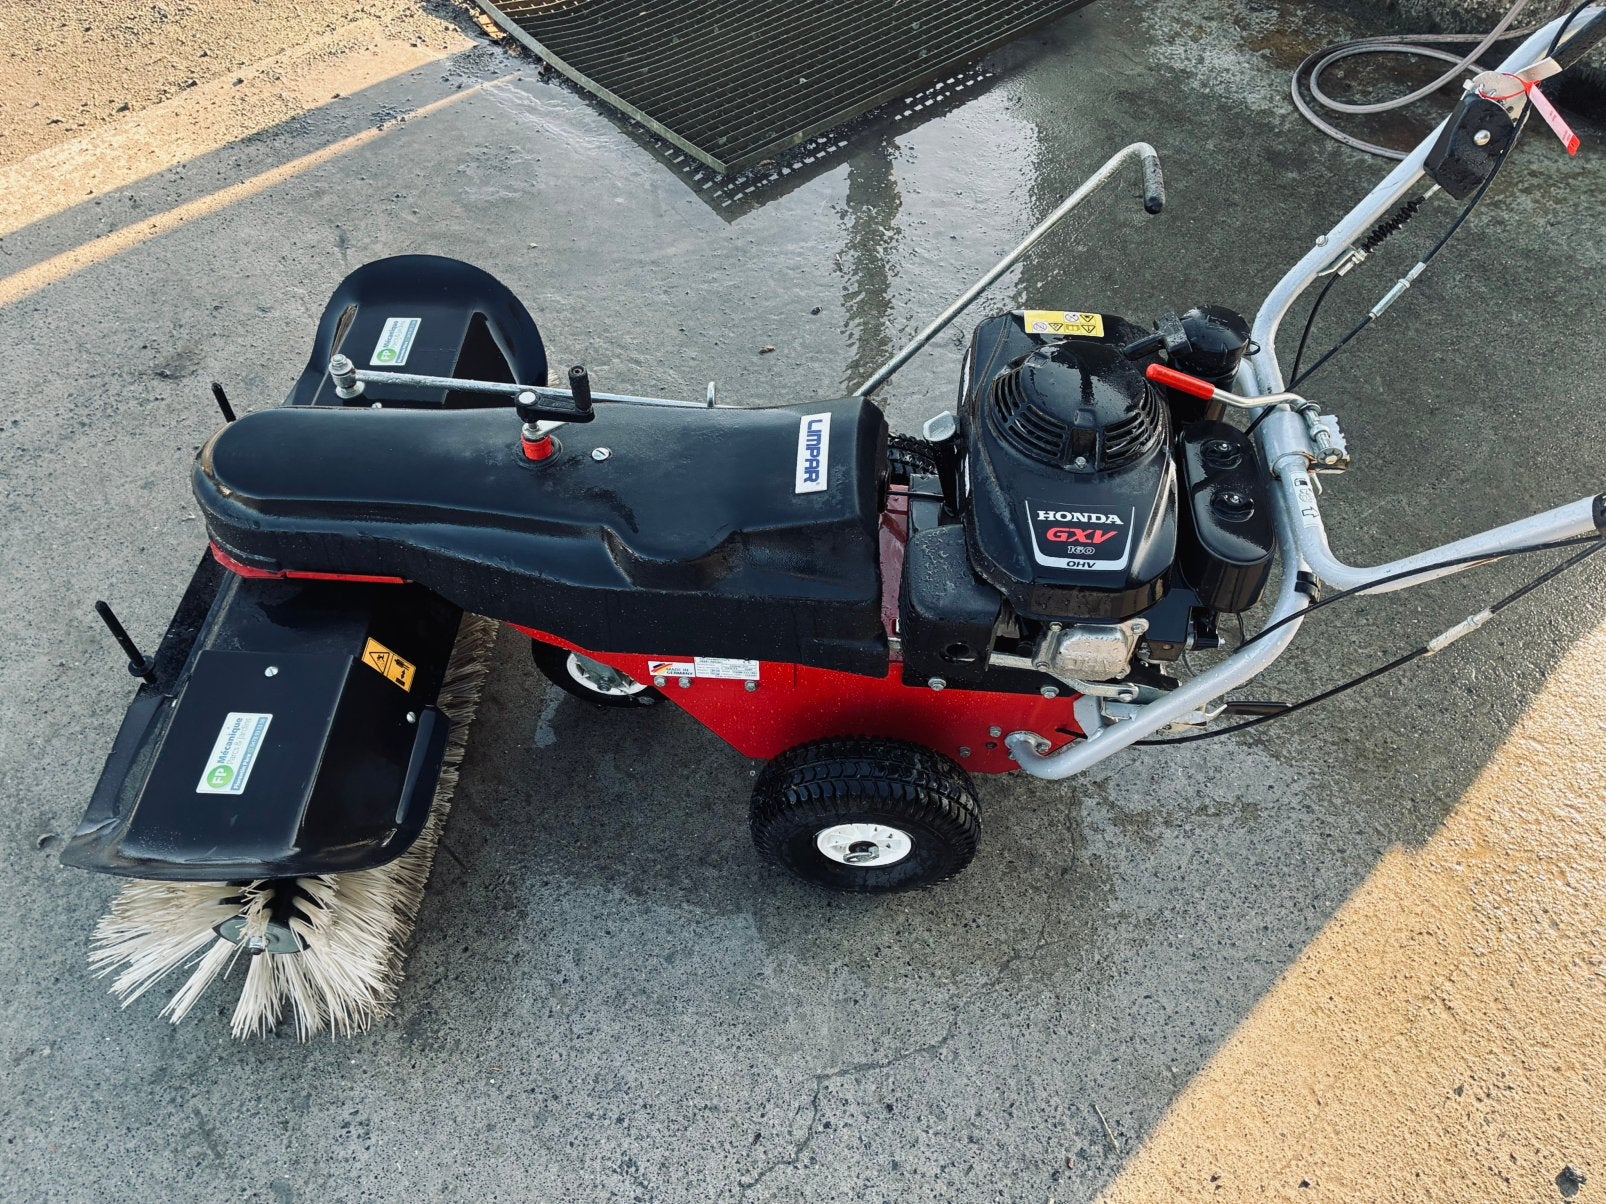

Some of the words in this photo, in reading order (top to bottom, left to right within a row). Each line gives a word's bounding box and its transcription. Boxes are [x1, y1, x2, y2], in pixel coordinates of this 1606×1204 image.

[380, 350, 391, 360] FP
[803, 419, 823, 483] LIMPAR
[1036, 510, 1124, 525] HONDA
[1046, 527, 1119, 544] GXV
[1067, 545, 1096, 555] 160
[1066, 560, 1096, 569] OHV
[217, 717, 243, 764] Mécanique
[212, 767, 227, 784] FP
